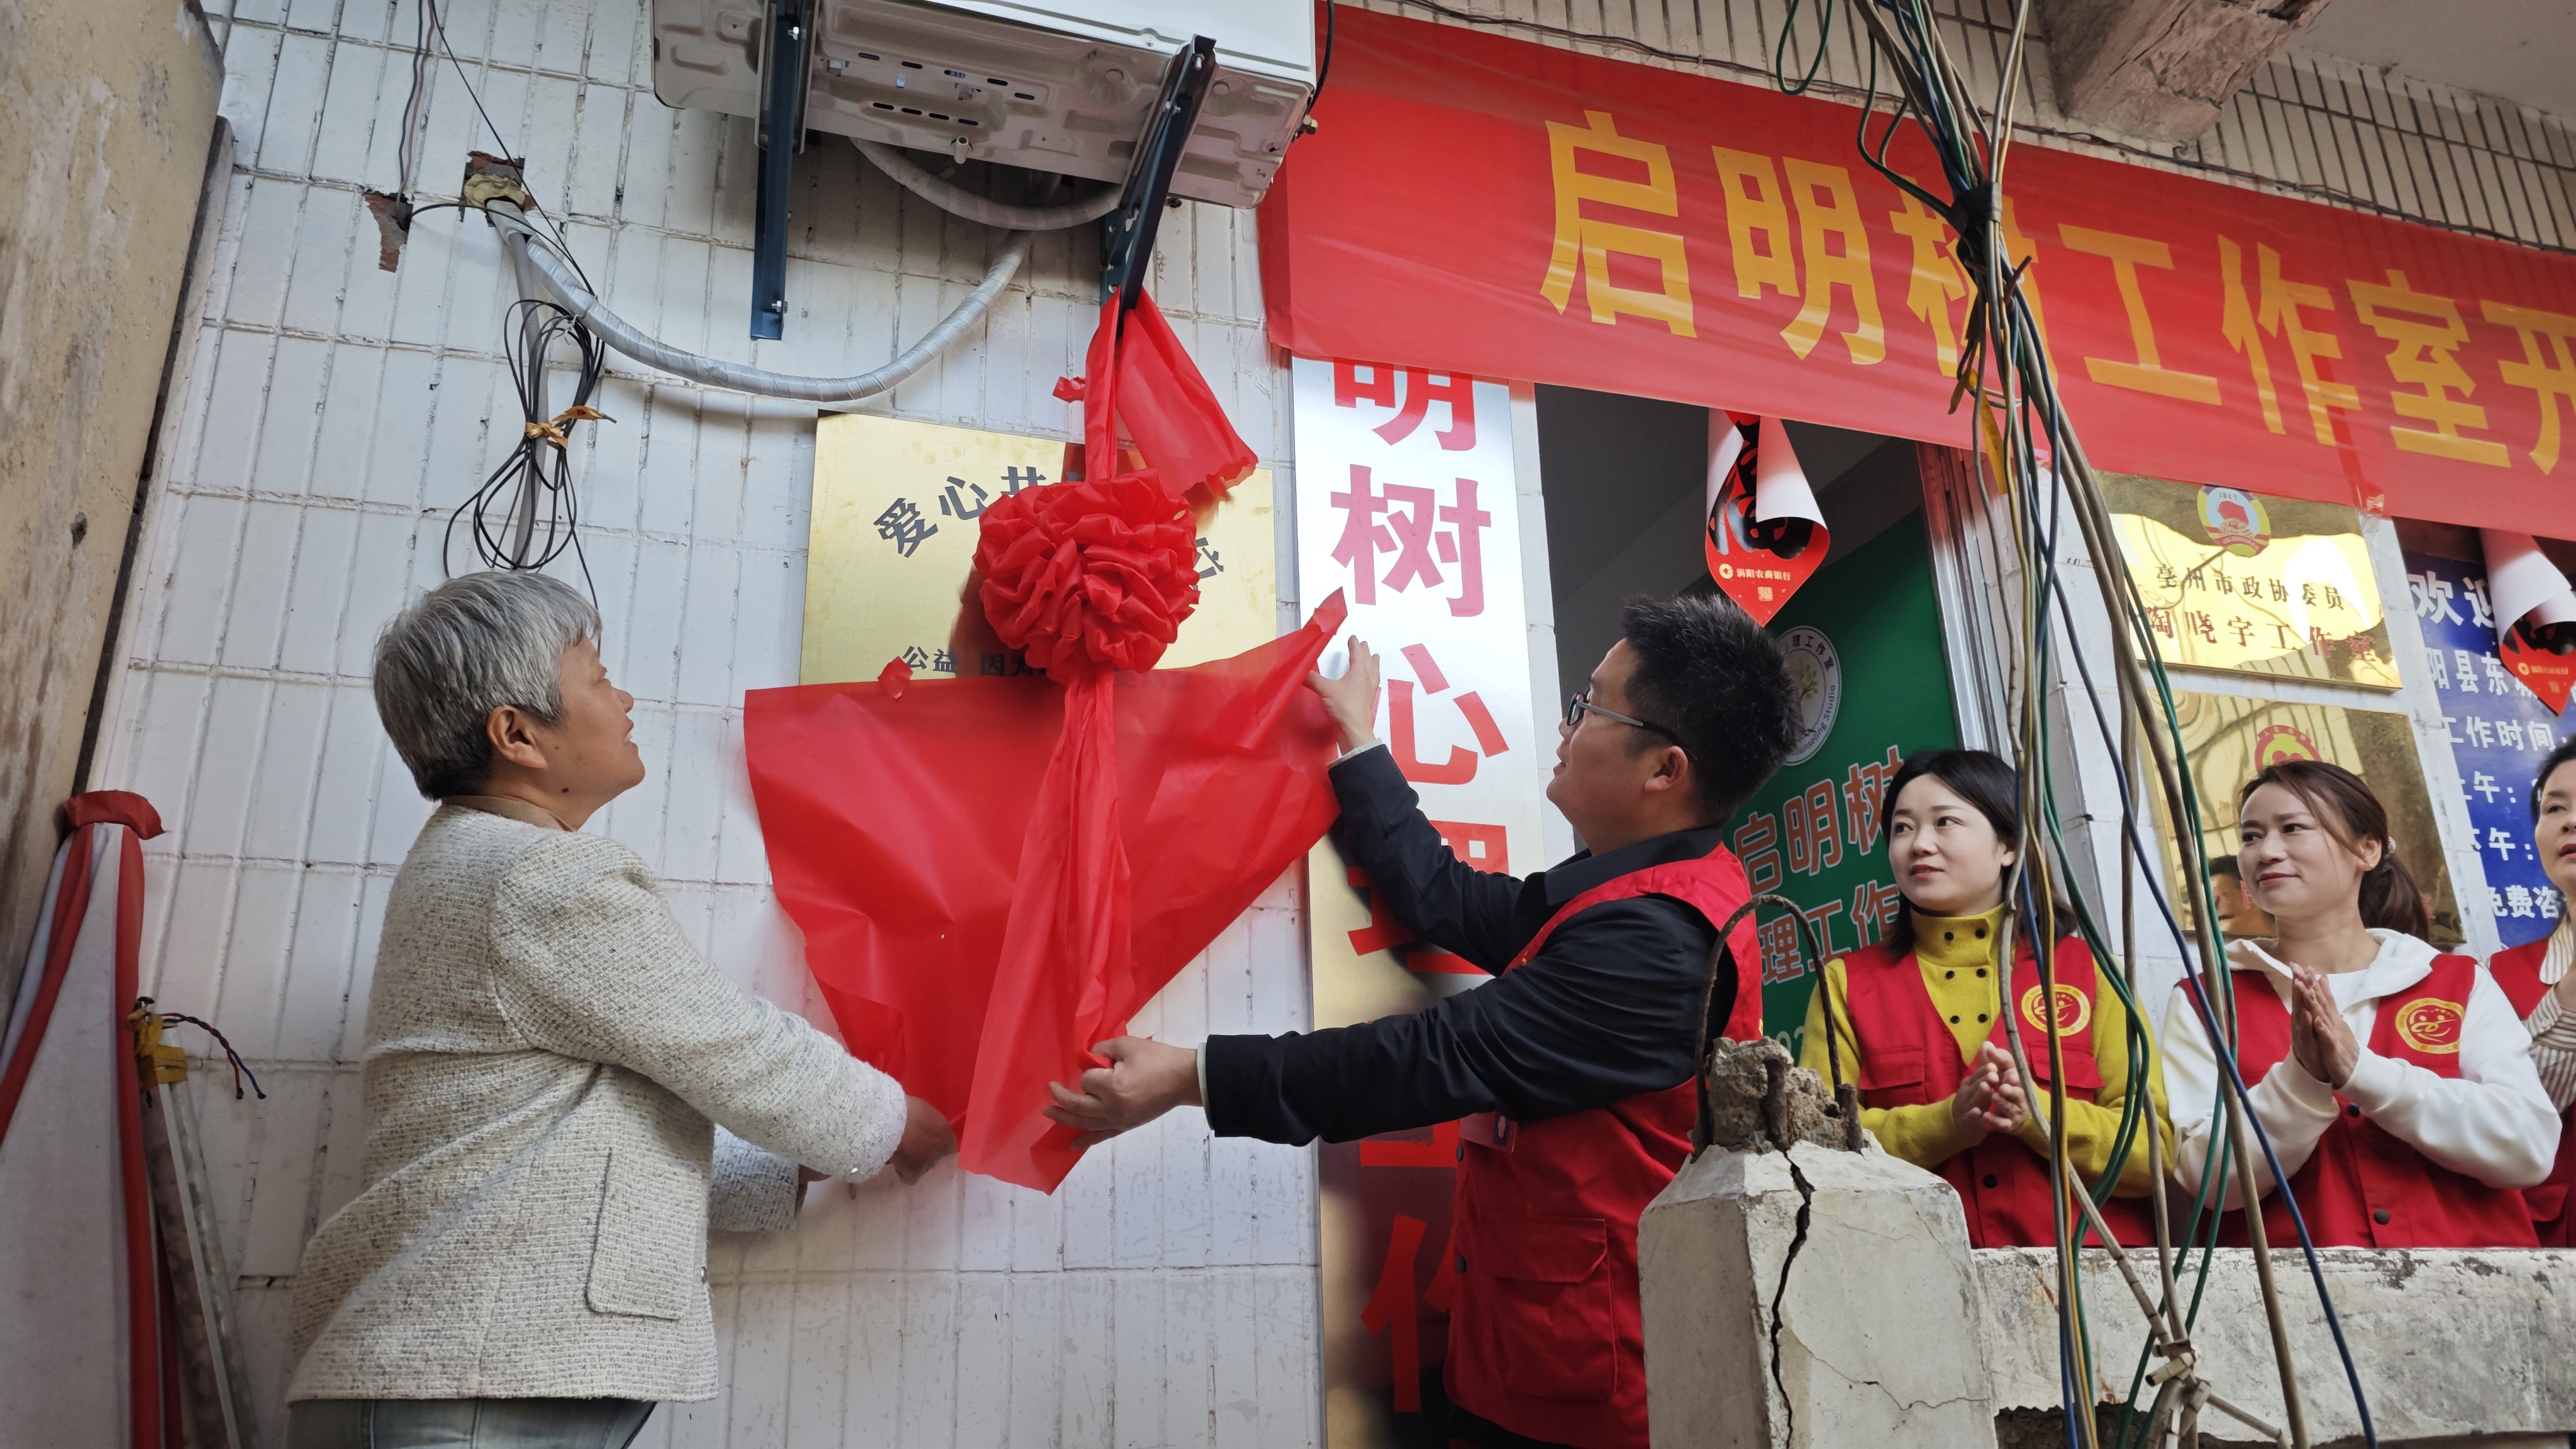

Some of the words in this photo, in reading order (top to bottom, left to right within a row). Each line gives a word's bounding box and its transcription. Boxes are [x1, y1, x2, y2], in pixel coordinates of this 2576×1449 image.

[2155, 563, 2345, 611] 亳州市政协委员
[2145, 606, 2375, 662] 陶晓宇工作室
[1824, 685, 1836, 721] Studio
